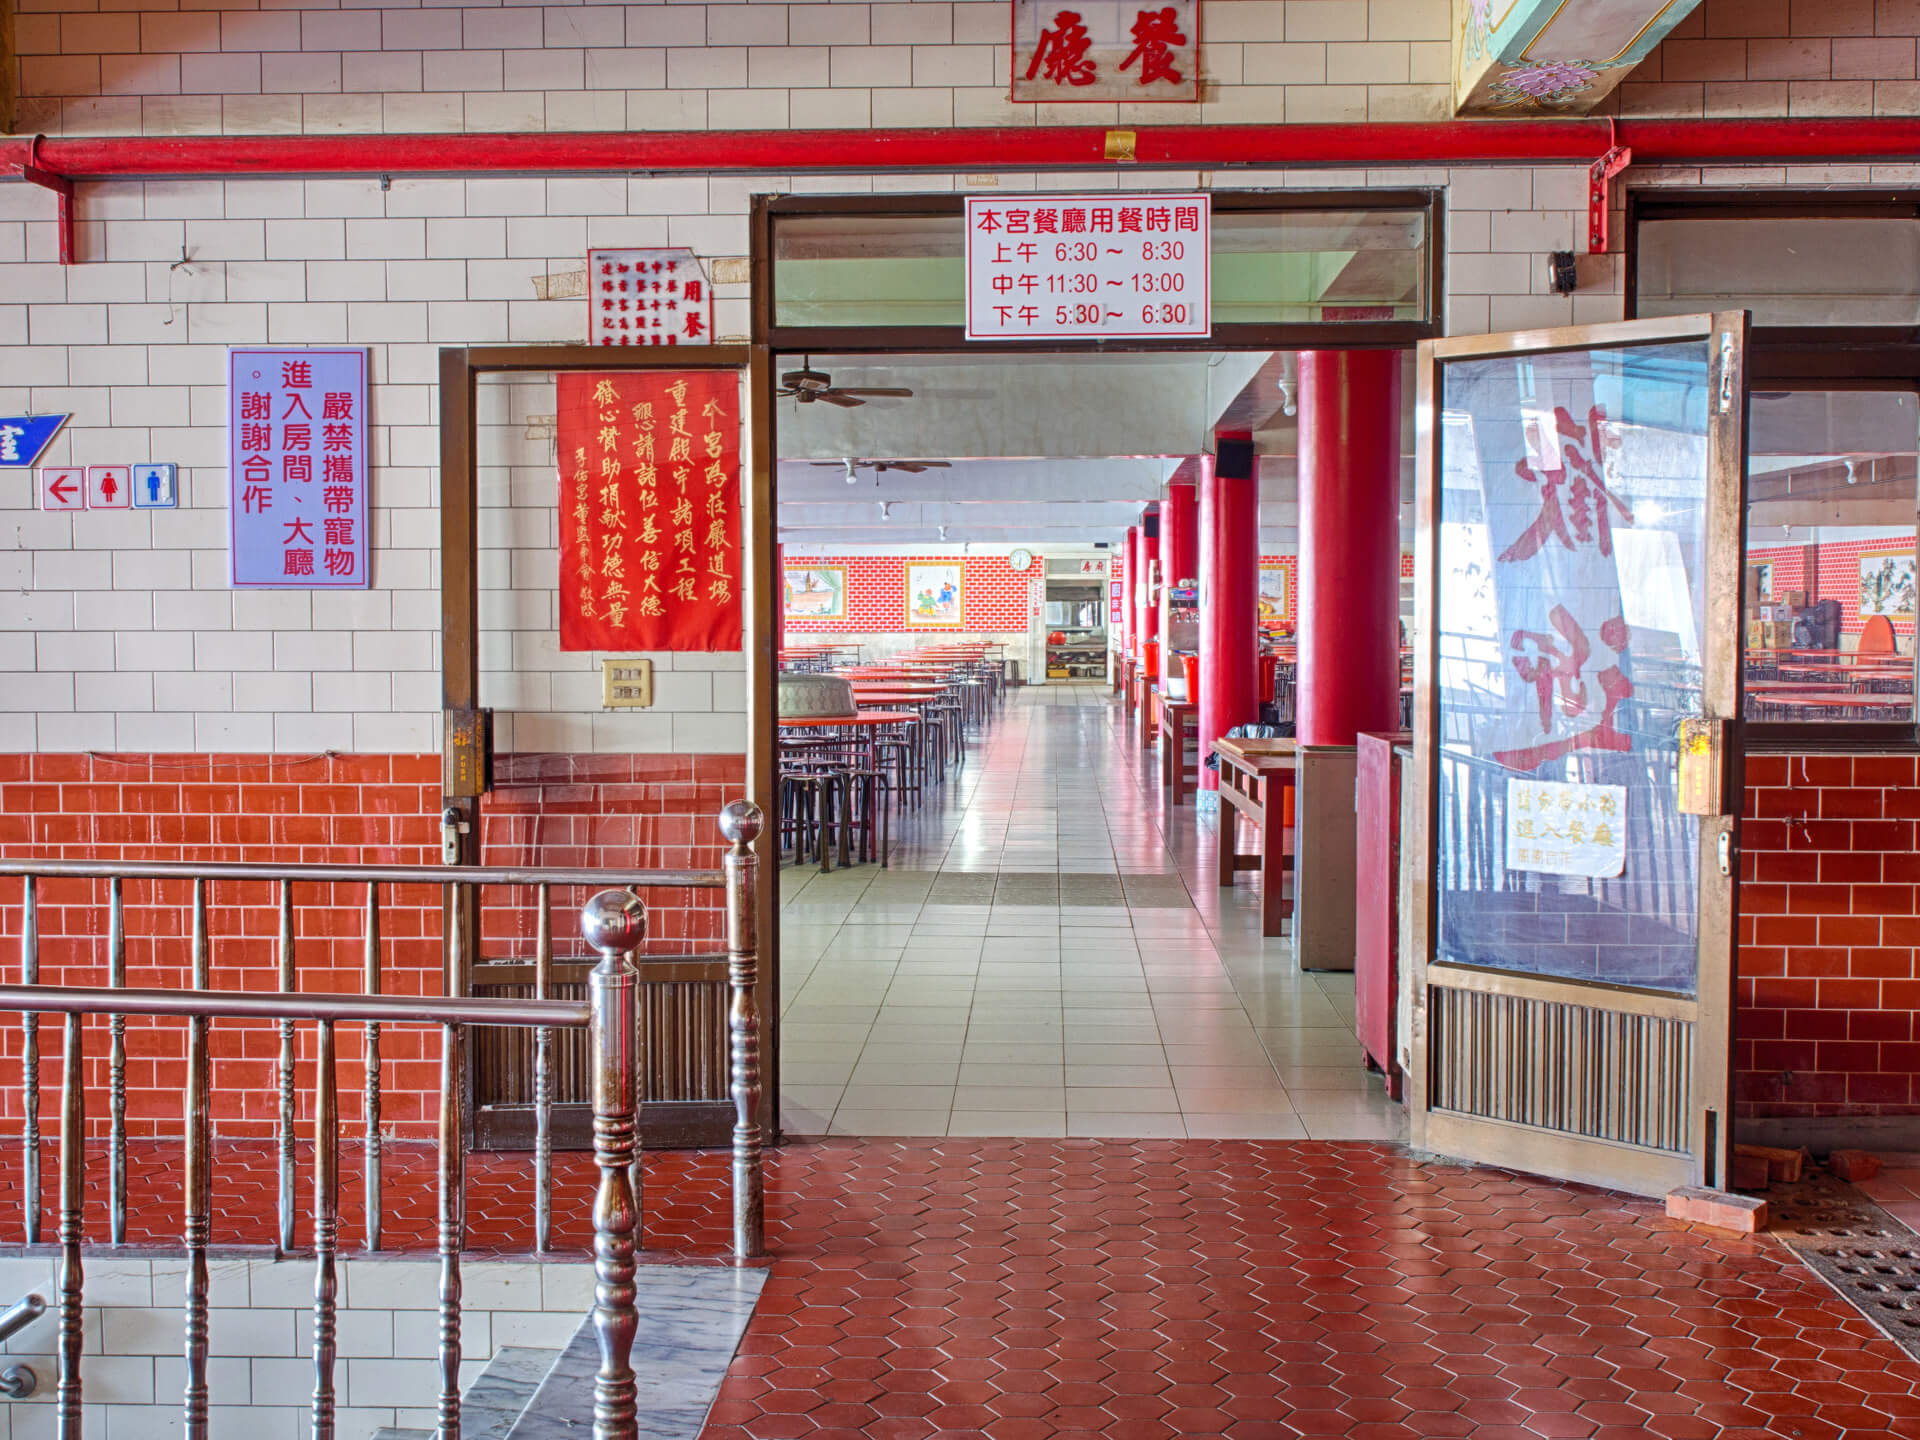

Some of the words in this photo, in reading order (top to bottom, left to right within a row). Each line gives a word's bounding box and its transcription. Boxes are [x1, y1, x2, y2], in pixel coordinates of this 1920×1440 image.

[1026, 7, 1187, 87] 餐廳
[977, 206, 1199, 235] 本宮餐廳用餐時間
[991, 242, 1038, 264] 上午
[1055, 242, 1098, 262] 6:30
[1142, 241, 1185, 261] 8:30
[992, 273, 1039, 295] 中午
[1047, 274, 1098, 294] 11:30
[1131, 273, 1185, 293] 13:00
[682, 280, 706, 339] 用餐
[992, 305, 1040, 327] 下午
[1055, 303, 1100, 325] 5:30
[1142, 303, 1187, 324] 6:30
[281, 360, 315, 577] 進入房間、大廳
[322, 391, 355, 577] 嚴禁攜帶寵物
